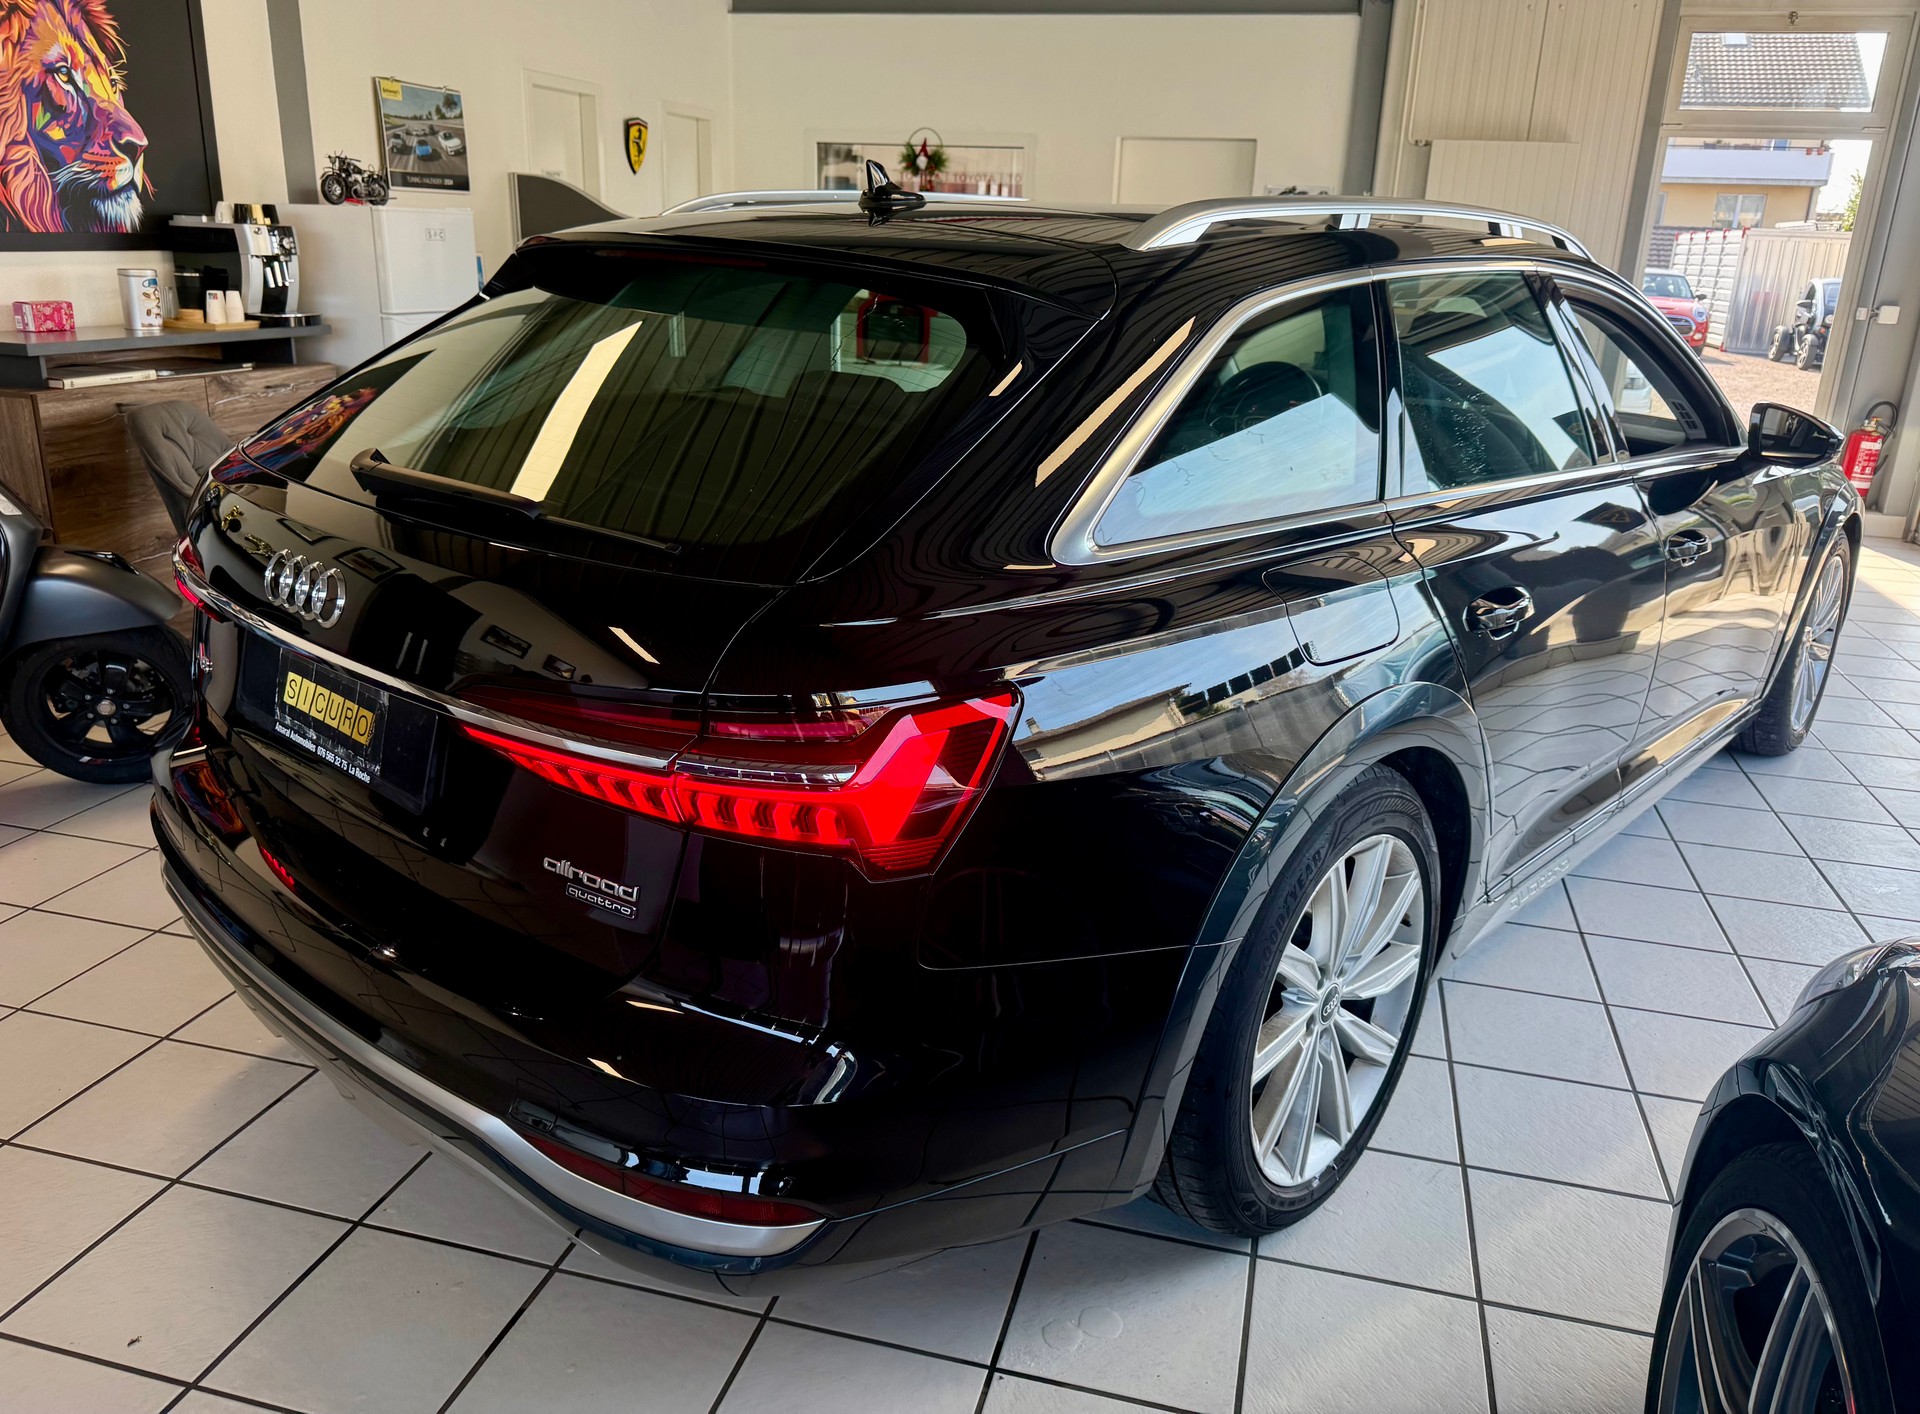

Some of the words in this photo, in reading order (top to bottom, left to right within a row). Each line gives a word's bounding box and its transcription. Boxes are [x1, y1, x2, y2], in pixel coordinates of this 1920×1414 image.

[287, 678, 369, 737] SICURO
[275, 721, 291, 738] Amaral
[290, 730, 316, 753] Automobiles
[316, 745, 326, 759] 076
[341, 760, 349, 771] 75
[348, 763, 356, 775] La
[355, 767, 371, 784] Roche
[543, 857, 639, 902] allroad
[568, 887, 631, 914] quattro
